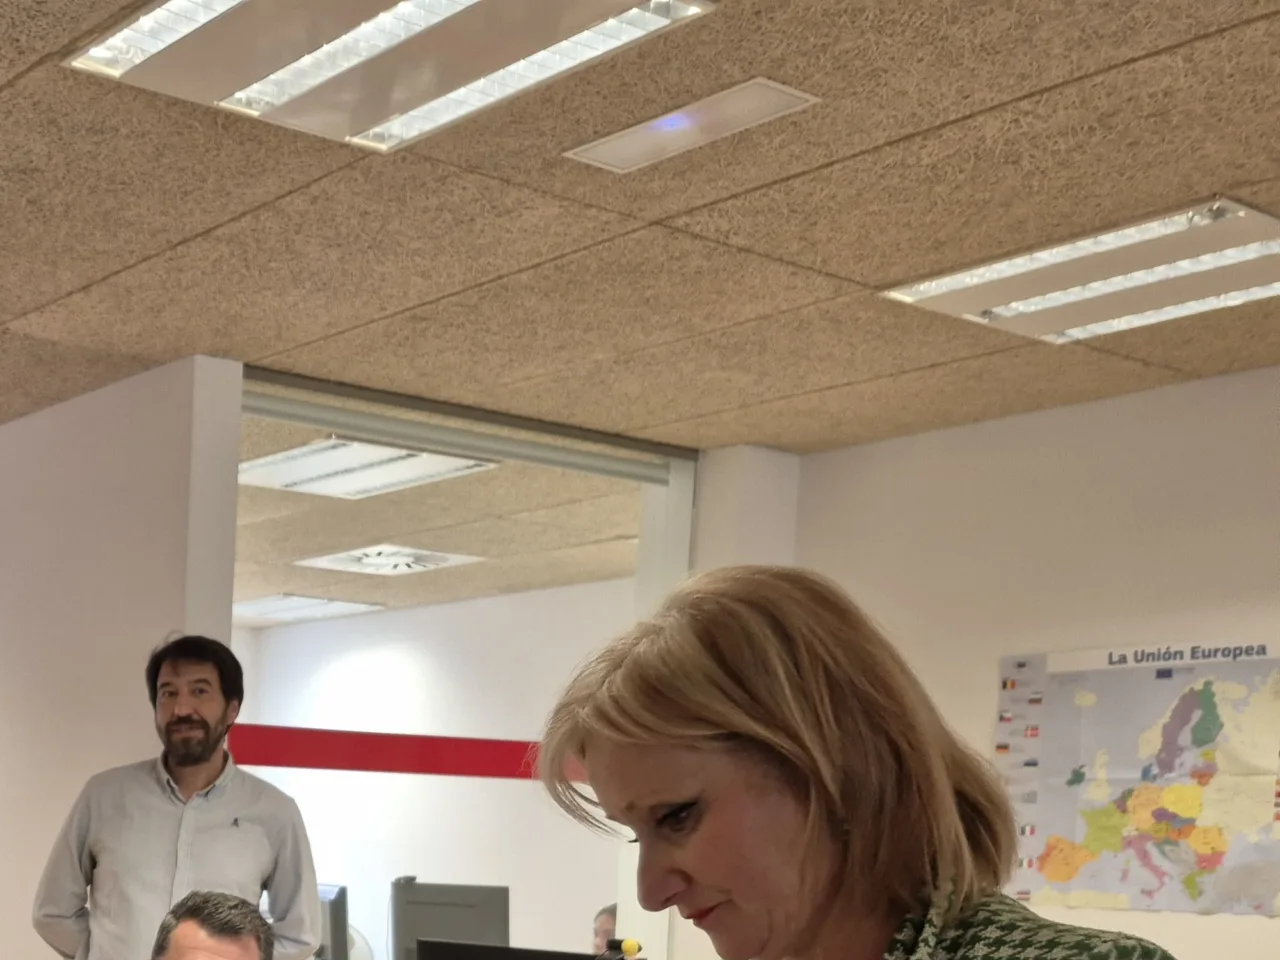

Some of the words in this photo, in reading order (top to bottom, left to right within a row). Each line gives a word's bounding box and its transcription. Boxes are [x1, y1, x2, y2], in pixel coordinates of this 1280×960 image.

[1108, 651, 1127, 666] La
[1133, 646, 1184, 664] Unión
[1190, 644, 1267, 662] Europea
